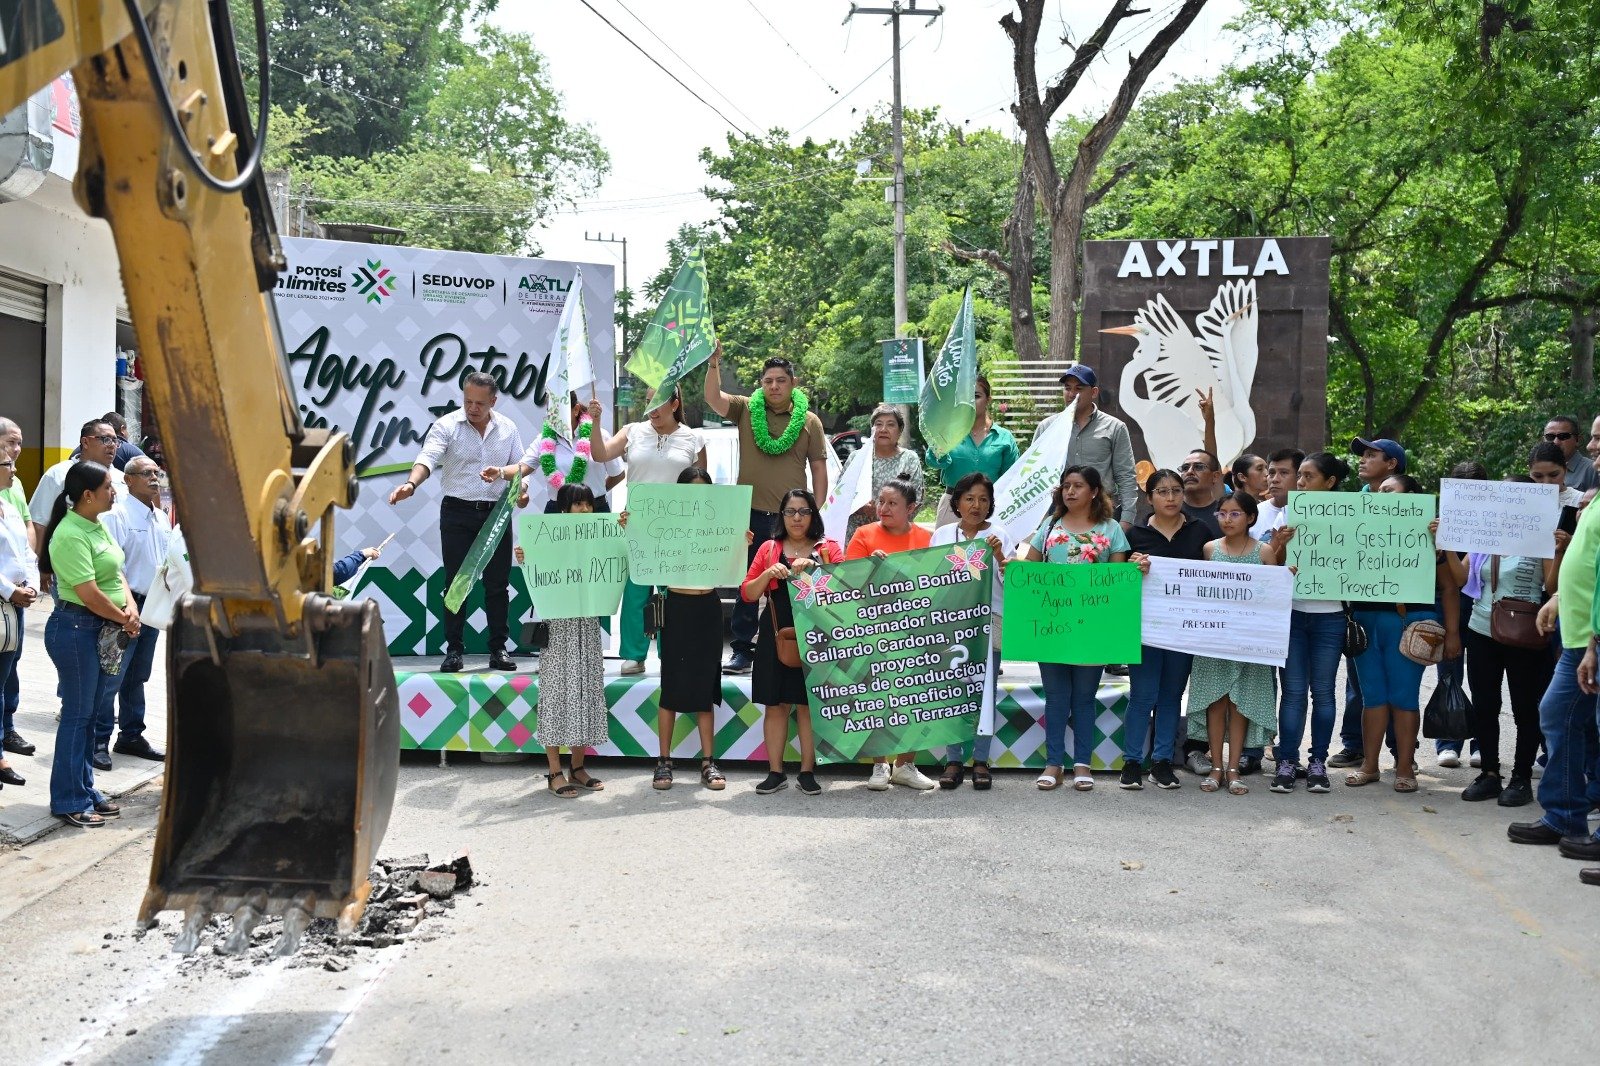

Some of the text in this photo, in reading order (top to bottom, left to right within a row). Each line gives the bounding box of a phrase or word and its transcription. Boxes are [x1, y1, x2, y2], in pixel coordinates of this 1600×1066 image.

[1117, 239, 1290, 278] AXTLA
[296, 265, 343, 278] POTOSÍ
[422, 274, 495, 290] SEDUVOP
[534, 293, 567, 301] TERRAZ
[287, 325, 406, 407] Agua
[420, 332, 551, 407] Potabl
[1443, 478, 1554, 496] Bienvenido Gobernador
[1454, 490, 1487, 501] Ricardo
[628, 484, 716, 520] GRACIAS
[1293, 493, 1424, 519] Gracias Presidenta
[647, 517, 736, 543] GOBERNADOR
[1296, 522, 1428, 549] Por la Gestión
[1507, 530, 1523, 540] del
[654, 543, 683, 559] HACER
[1293, 549, 1420, 571] Y Hacer Realidad
[566, 568, 583, 585] POR
[1010, 565, 1138, 589] Gracias Padrino
[1178, 568, 1252, 582] FRACCIONAMIENTO
[1296, 572, 1400, 597] Este Proyecto
[815, 569, 972, 607] Fracc. Loma Bonita
[1165, 583, 1253, 601] LA REALIDAD
[856, 597, 932, 620] agradece
[805, 603, 991, 645] Sr. Gobernador Ricardo
[1182, 619, 1228, 629] PRESENTE
[805, 642, 874, 664] Gallardo
[876, 631, 951, 653] Cardona,
[954, 626, 979, 643] por
[870, 652, 941, 677] proyecto
[811, 682, 867, 701] "líneas
[871, 676, 890, 693] de
[820, 702, 851, 720] que
[854, 698, 885, 714] trae
[888, 686, 963, 709] beneficio
[843, 700, 982, 734] Axtla de Terrazas.
